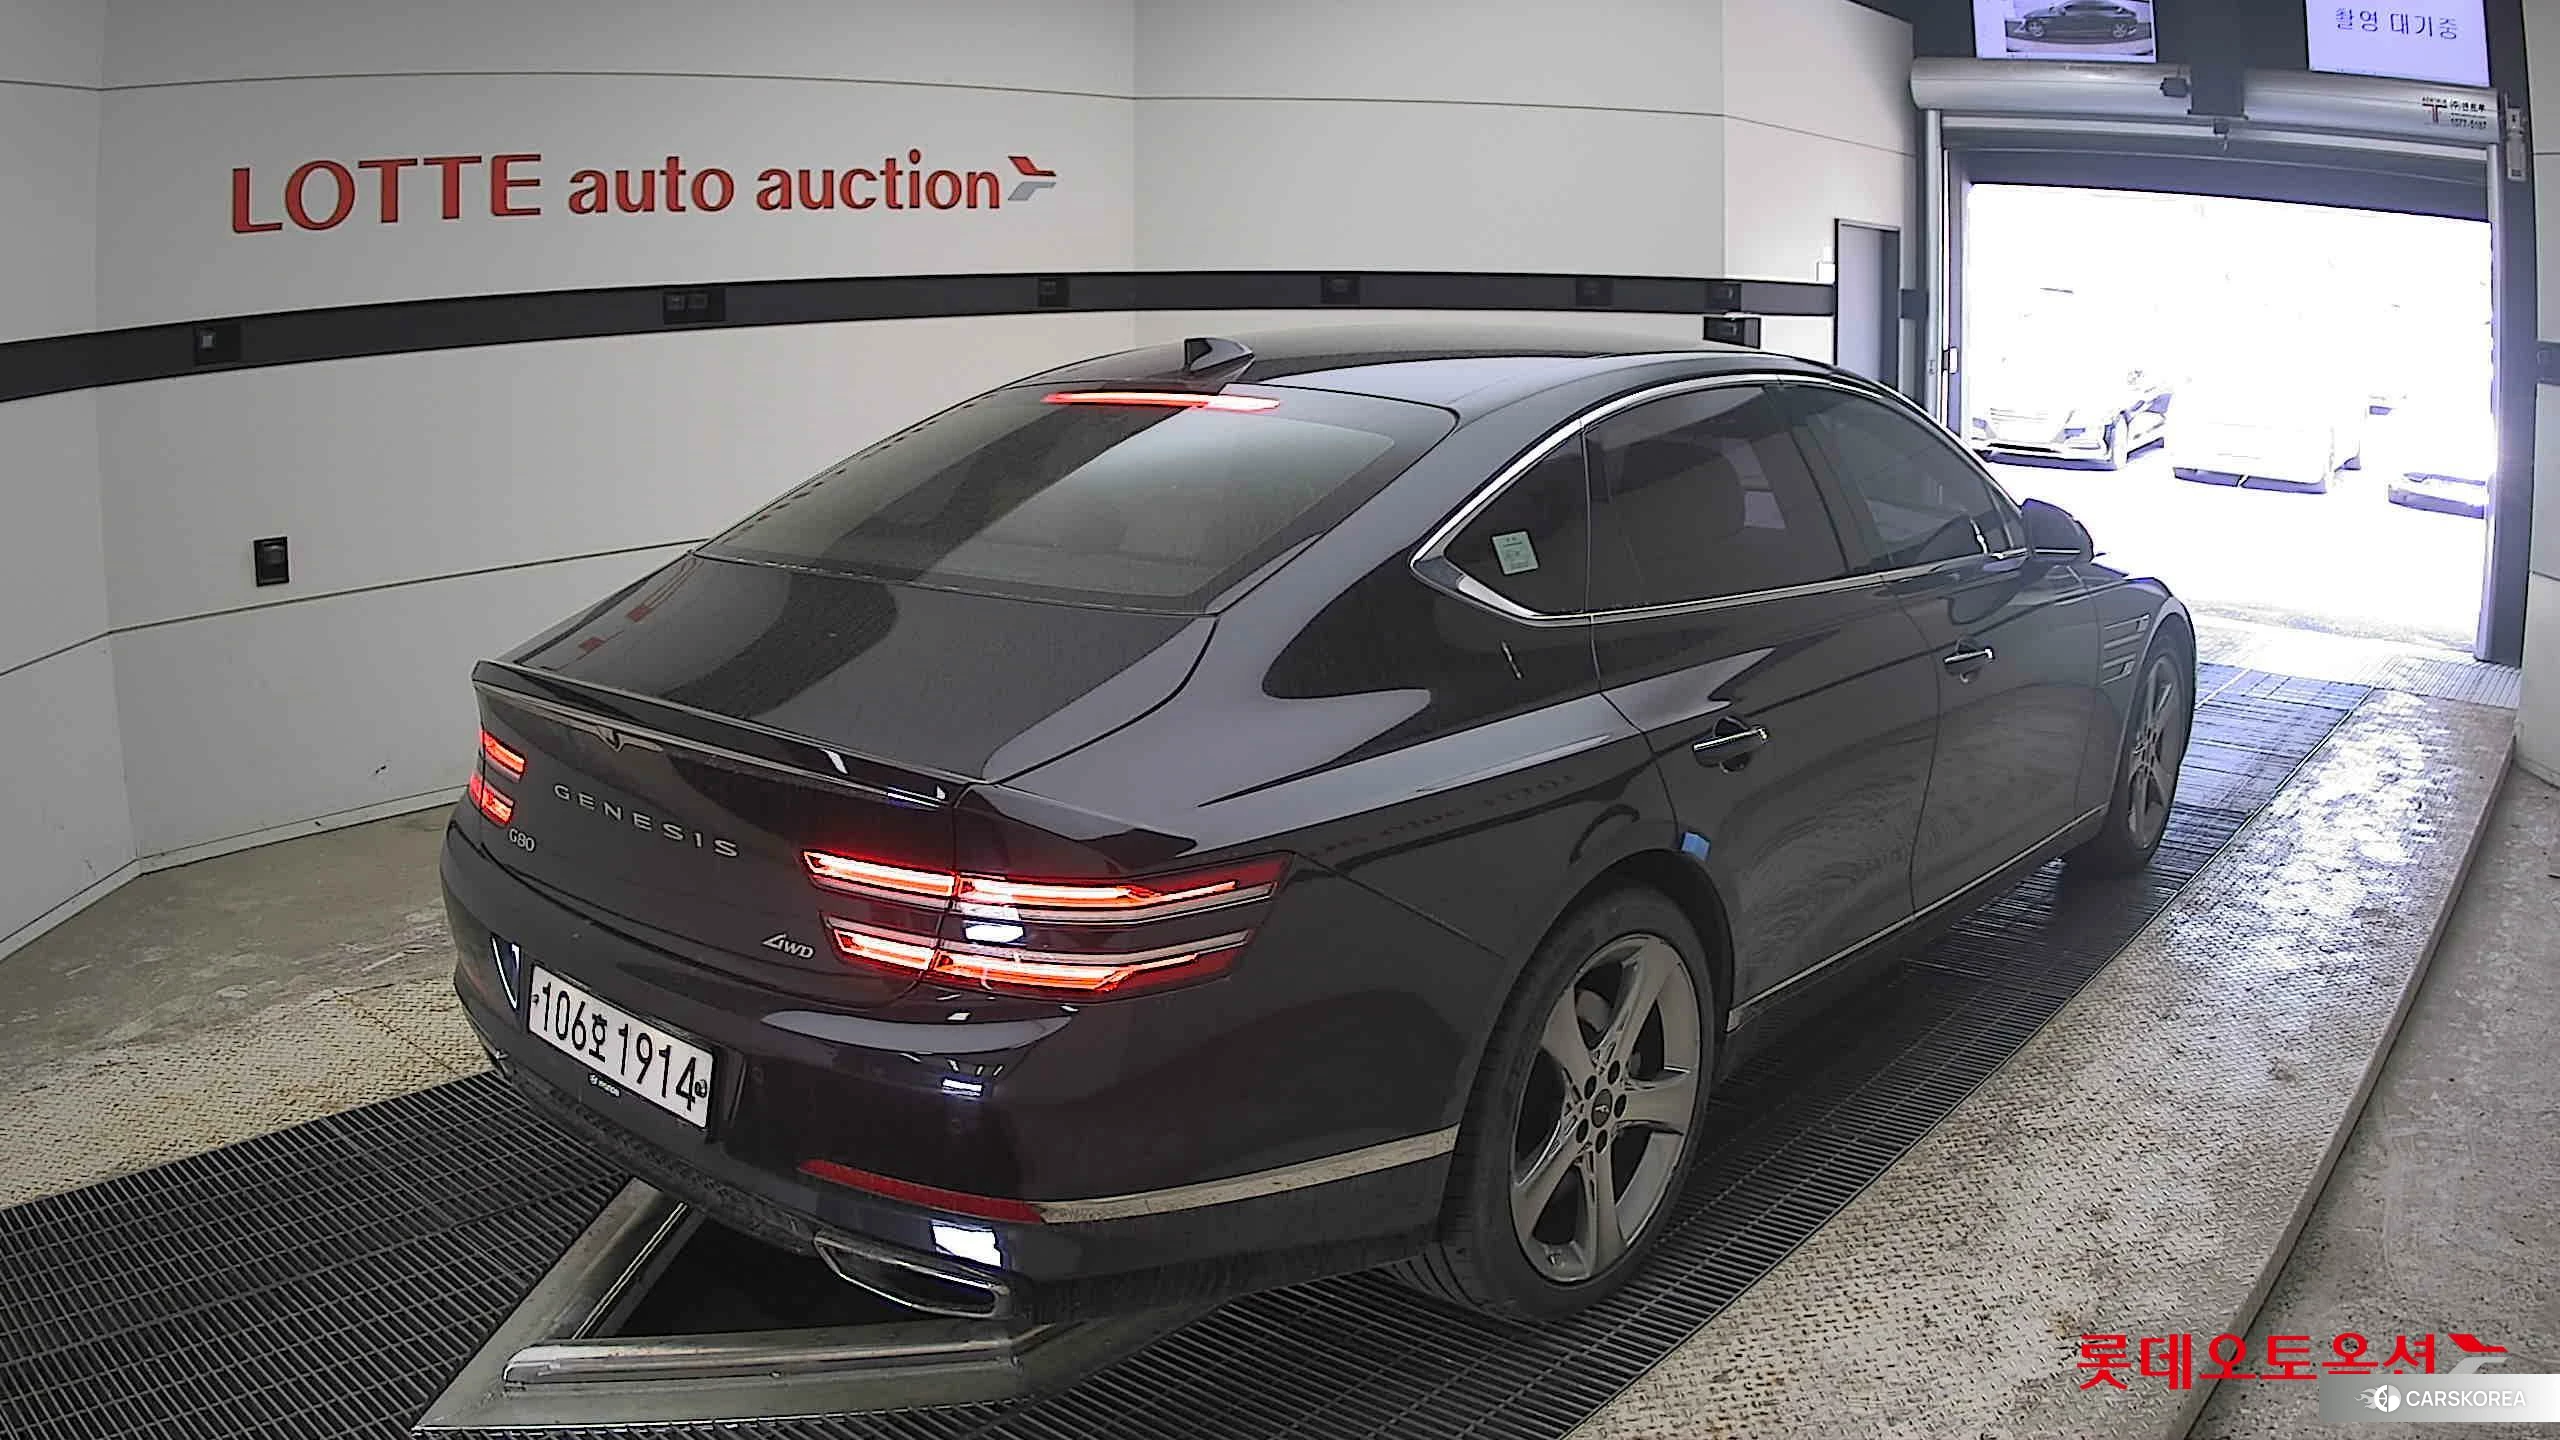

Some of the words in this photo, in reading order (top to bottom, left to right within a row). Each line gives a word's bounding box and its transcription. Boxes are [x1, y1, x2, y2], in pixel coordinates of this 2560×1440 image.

[2335, 7, 2379, 33] 촬영
[233, 154, 542, 233] LOTTE
[568, 156, 735, 213] auto
[756, 149, 1002, 210] auction
[509, 828, 535, 852] G80
[552, 783, 740, 858] GENESIS
[762, 933, 814, 958] 4WD
[542, 981, 607, 1063] 106호
[618, 1023, 697, 1113] 1914
